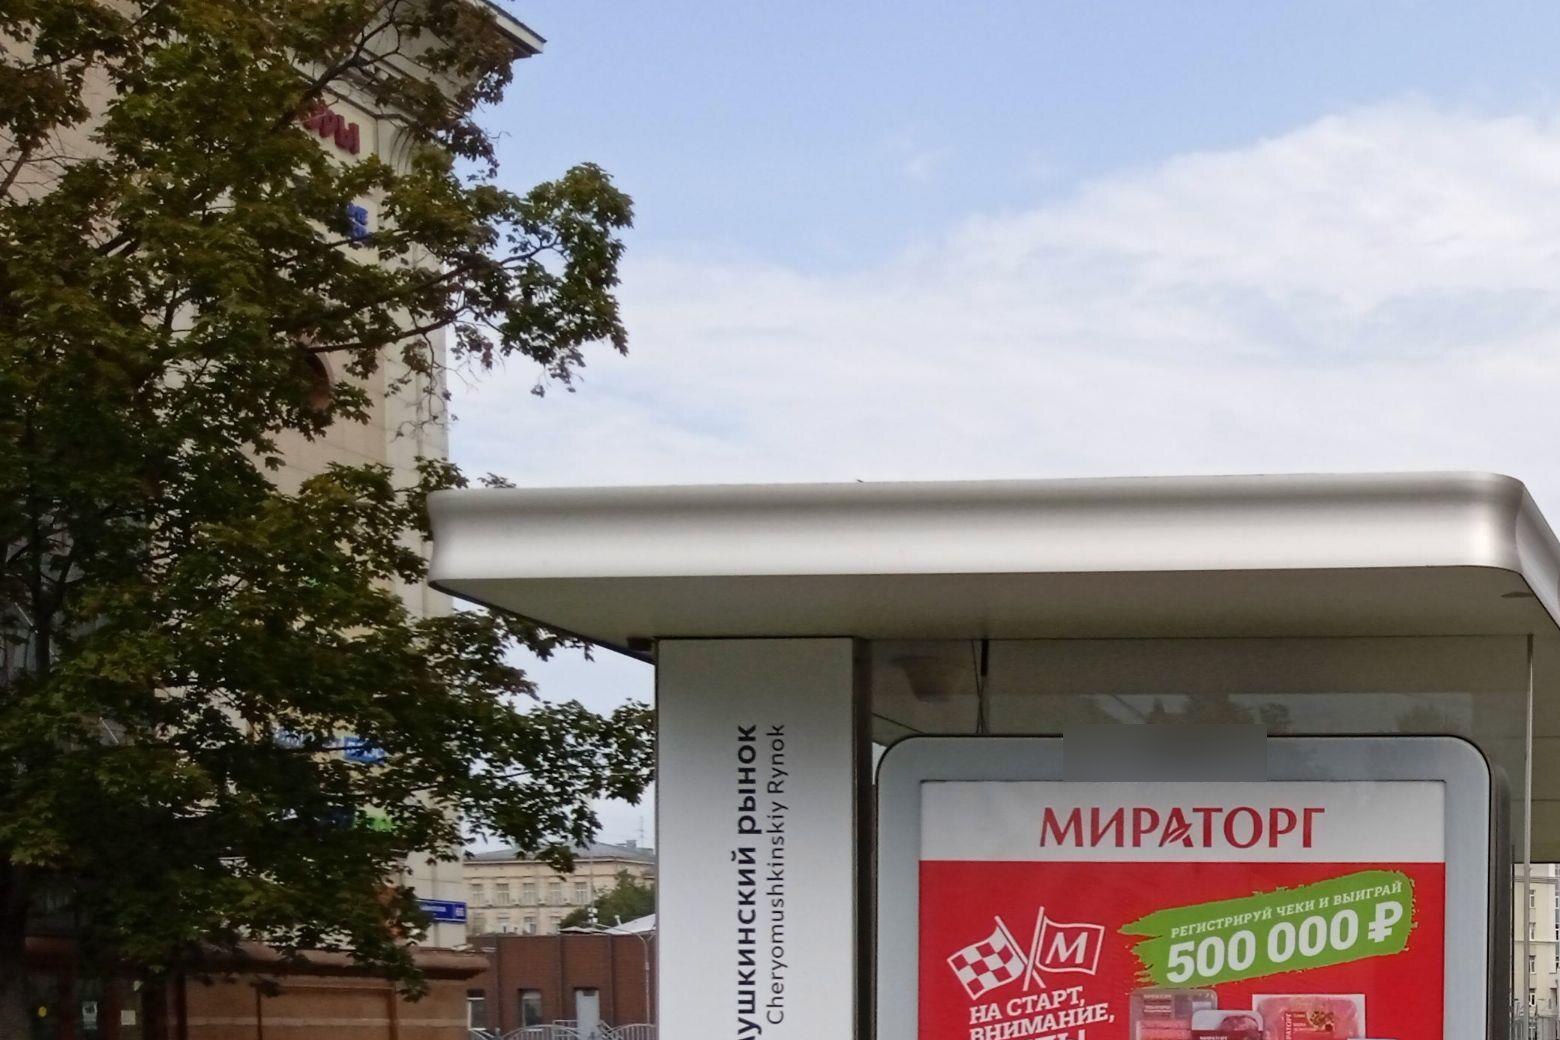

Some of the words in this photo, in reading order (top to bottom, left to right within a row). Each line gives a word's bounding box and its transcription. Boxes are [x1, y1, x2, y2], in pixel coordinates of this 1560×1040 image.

[738, 725, 762, 834] рынок
[766, 725, 788, 793] Rynok
[1040, 806, 1325, 849] МИРАТОРГ
[766, 801, 788, 1024] Cheryomushkinskiy
[1171, 907, 1273, 938] РЕГИСТРИРУЙ
[1276, 899, 1315, 916] ЧЕКИ
[1319, 896, 1330, 909] И
[1333, 880, 1403, 907] ВЫИГРАЙ
[1166, 929, 1256, 983] 500
[1267, 909, 1359, 963] 000
[969, 1003, 1002, 1025] НА
[1006, 986, 1085, 1017] СТАРТ,
